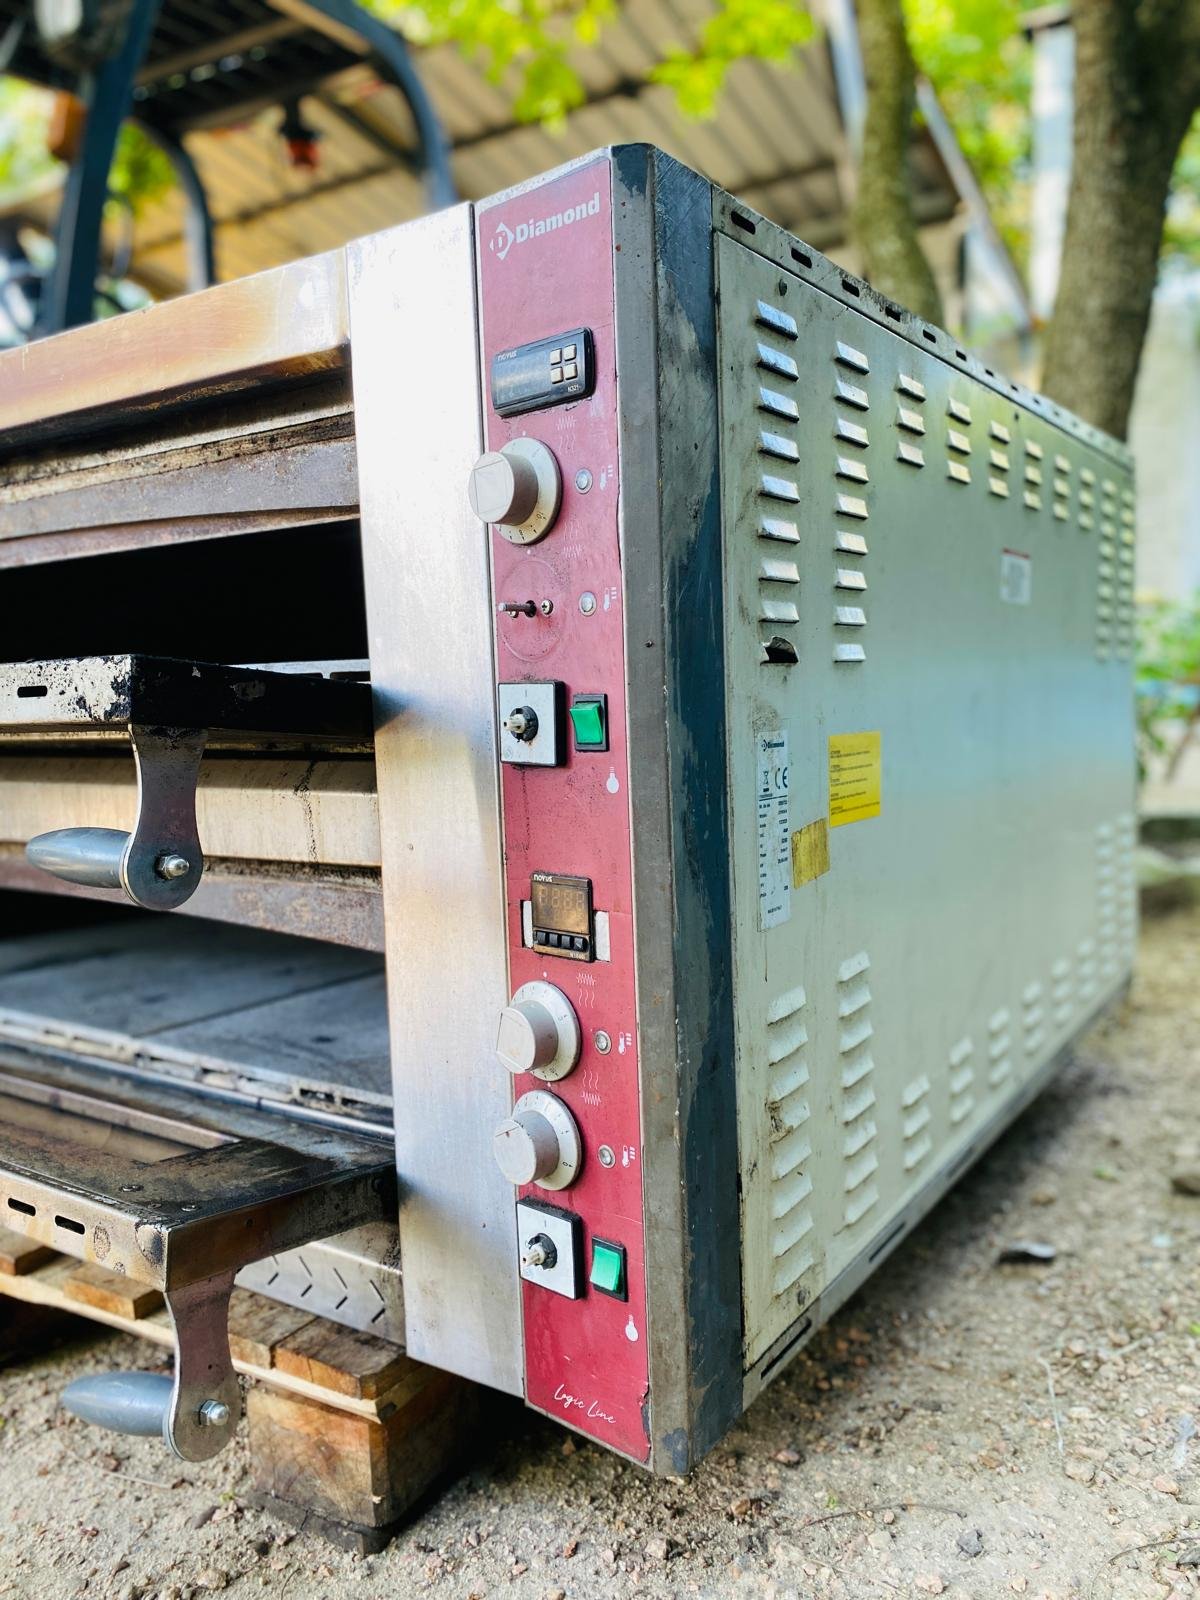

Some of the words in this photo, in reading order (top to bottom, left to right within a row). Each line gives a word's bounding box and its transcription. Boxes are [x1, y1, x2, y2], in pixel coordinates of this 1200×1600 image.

[515, 192, 600, 243] Diamond
[498, 351, 517, 361] novus
[775, 767, 788, 789] CE
[533, 874, 553, 882] novus
[554, 1384, 586, 1408] Logic
[587, 1400, 617, 1424] Line
